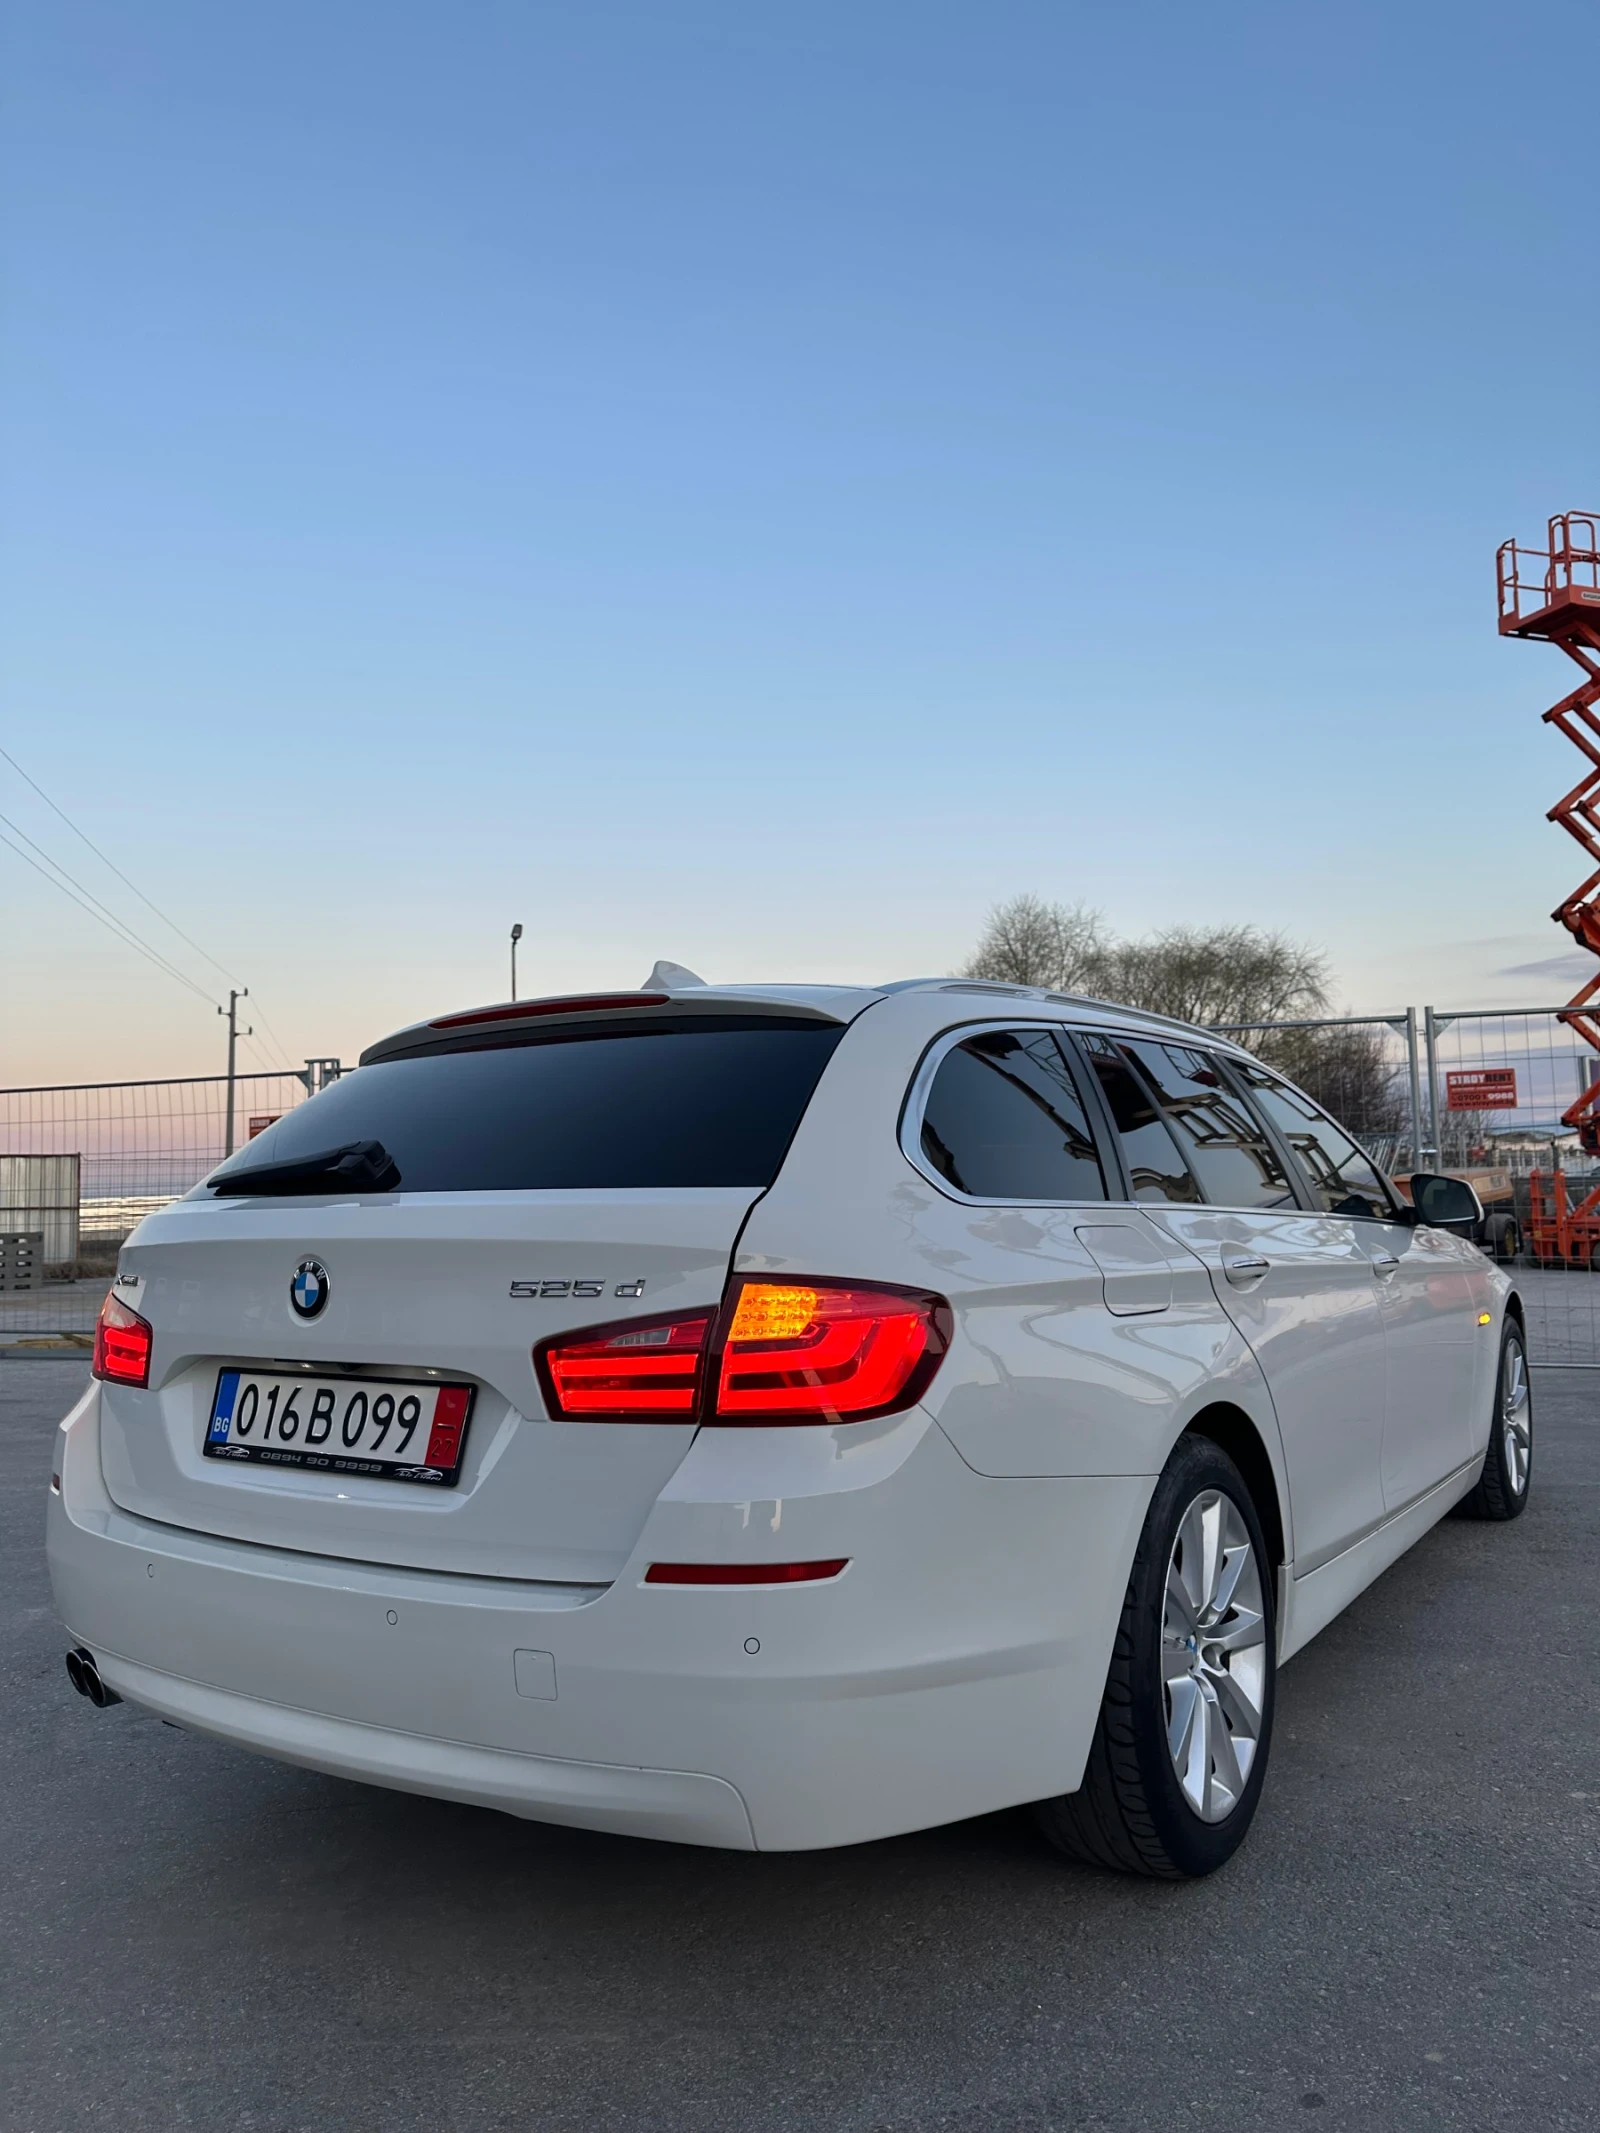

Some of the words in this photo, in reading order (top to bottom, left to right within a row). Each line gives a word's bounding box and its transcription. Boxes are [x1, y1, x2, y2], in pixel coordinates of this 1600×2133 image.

[294, 1262, 326, 1281] BMW
[509, 1279, 606, 1298] 525
[614, 1278, 646, 1298] d
[213, 1416, 230, 1433] BG
[431, 1437, 454, 1458] 27
[260, 1451, 302, 1463] 0894
[306, 1457, 329, 1467] 90
[334, 1460, 383, 1473] 9999
